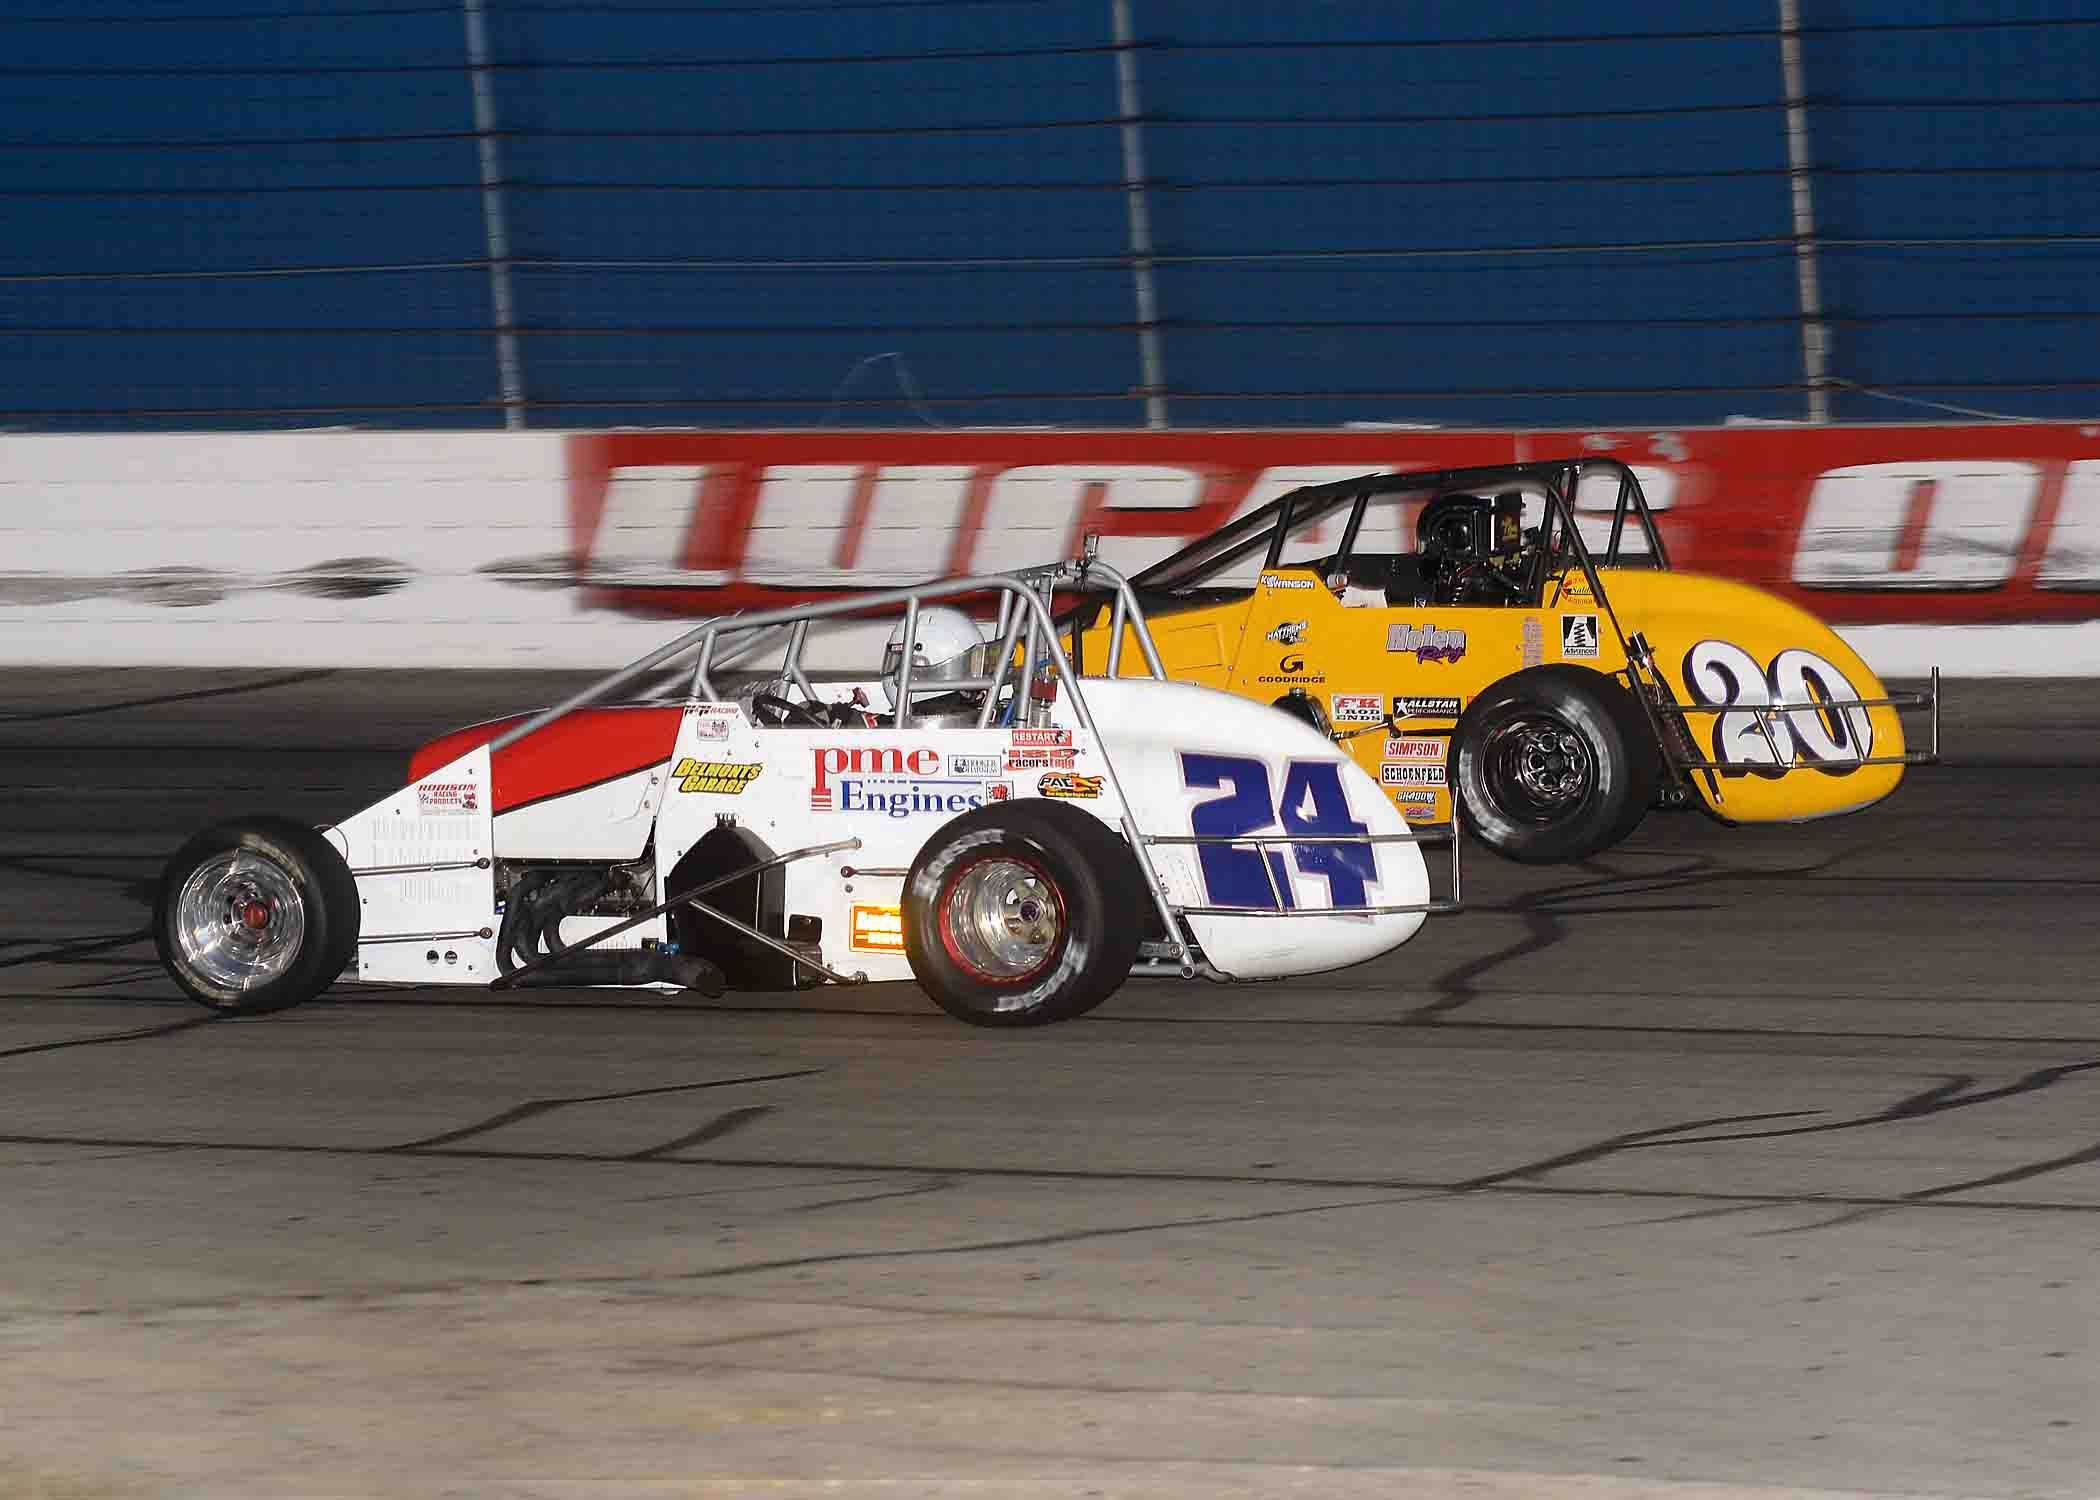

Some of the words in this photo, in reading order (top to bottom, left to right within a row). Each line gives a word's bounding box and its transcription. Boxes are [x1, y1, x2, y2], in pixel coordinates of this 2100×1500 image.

[1267, 579, 1314, 589] SWANSON
[1407, 700, 1458, 708] ALLSTAR
[1682, 640, 1873, 779] 20
[1012, 732, 1057, 741] RESTART
[1388, 742, 1440, 756] SIMPSON
[810, 747, 940, 797] pme
[1384, 767, 1444, 781] SCHOENFELD
[679, 775, 748, 794] GARAGE
[1039, 777, 1075, 788] PAC
[840, 780, 983, 818] Engines
[1178, 751, 1378, 918] 24
